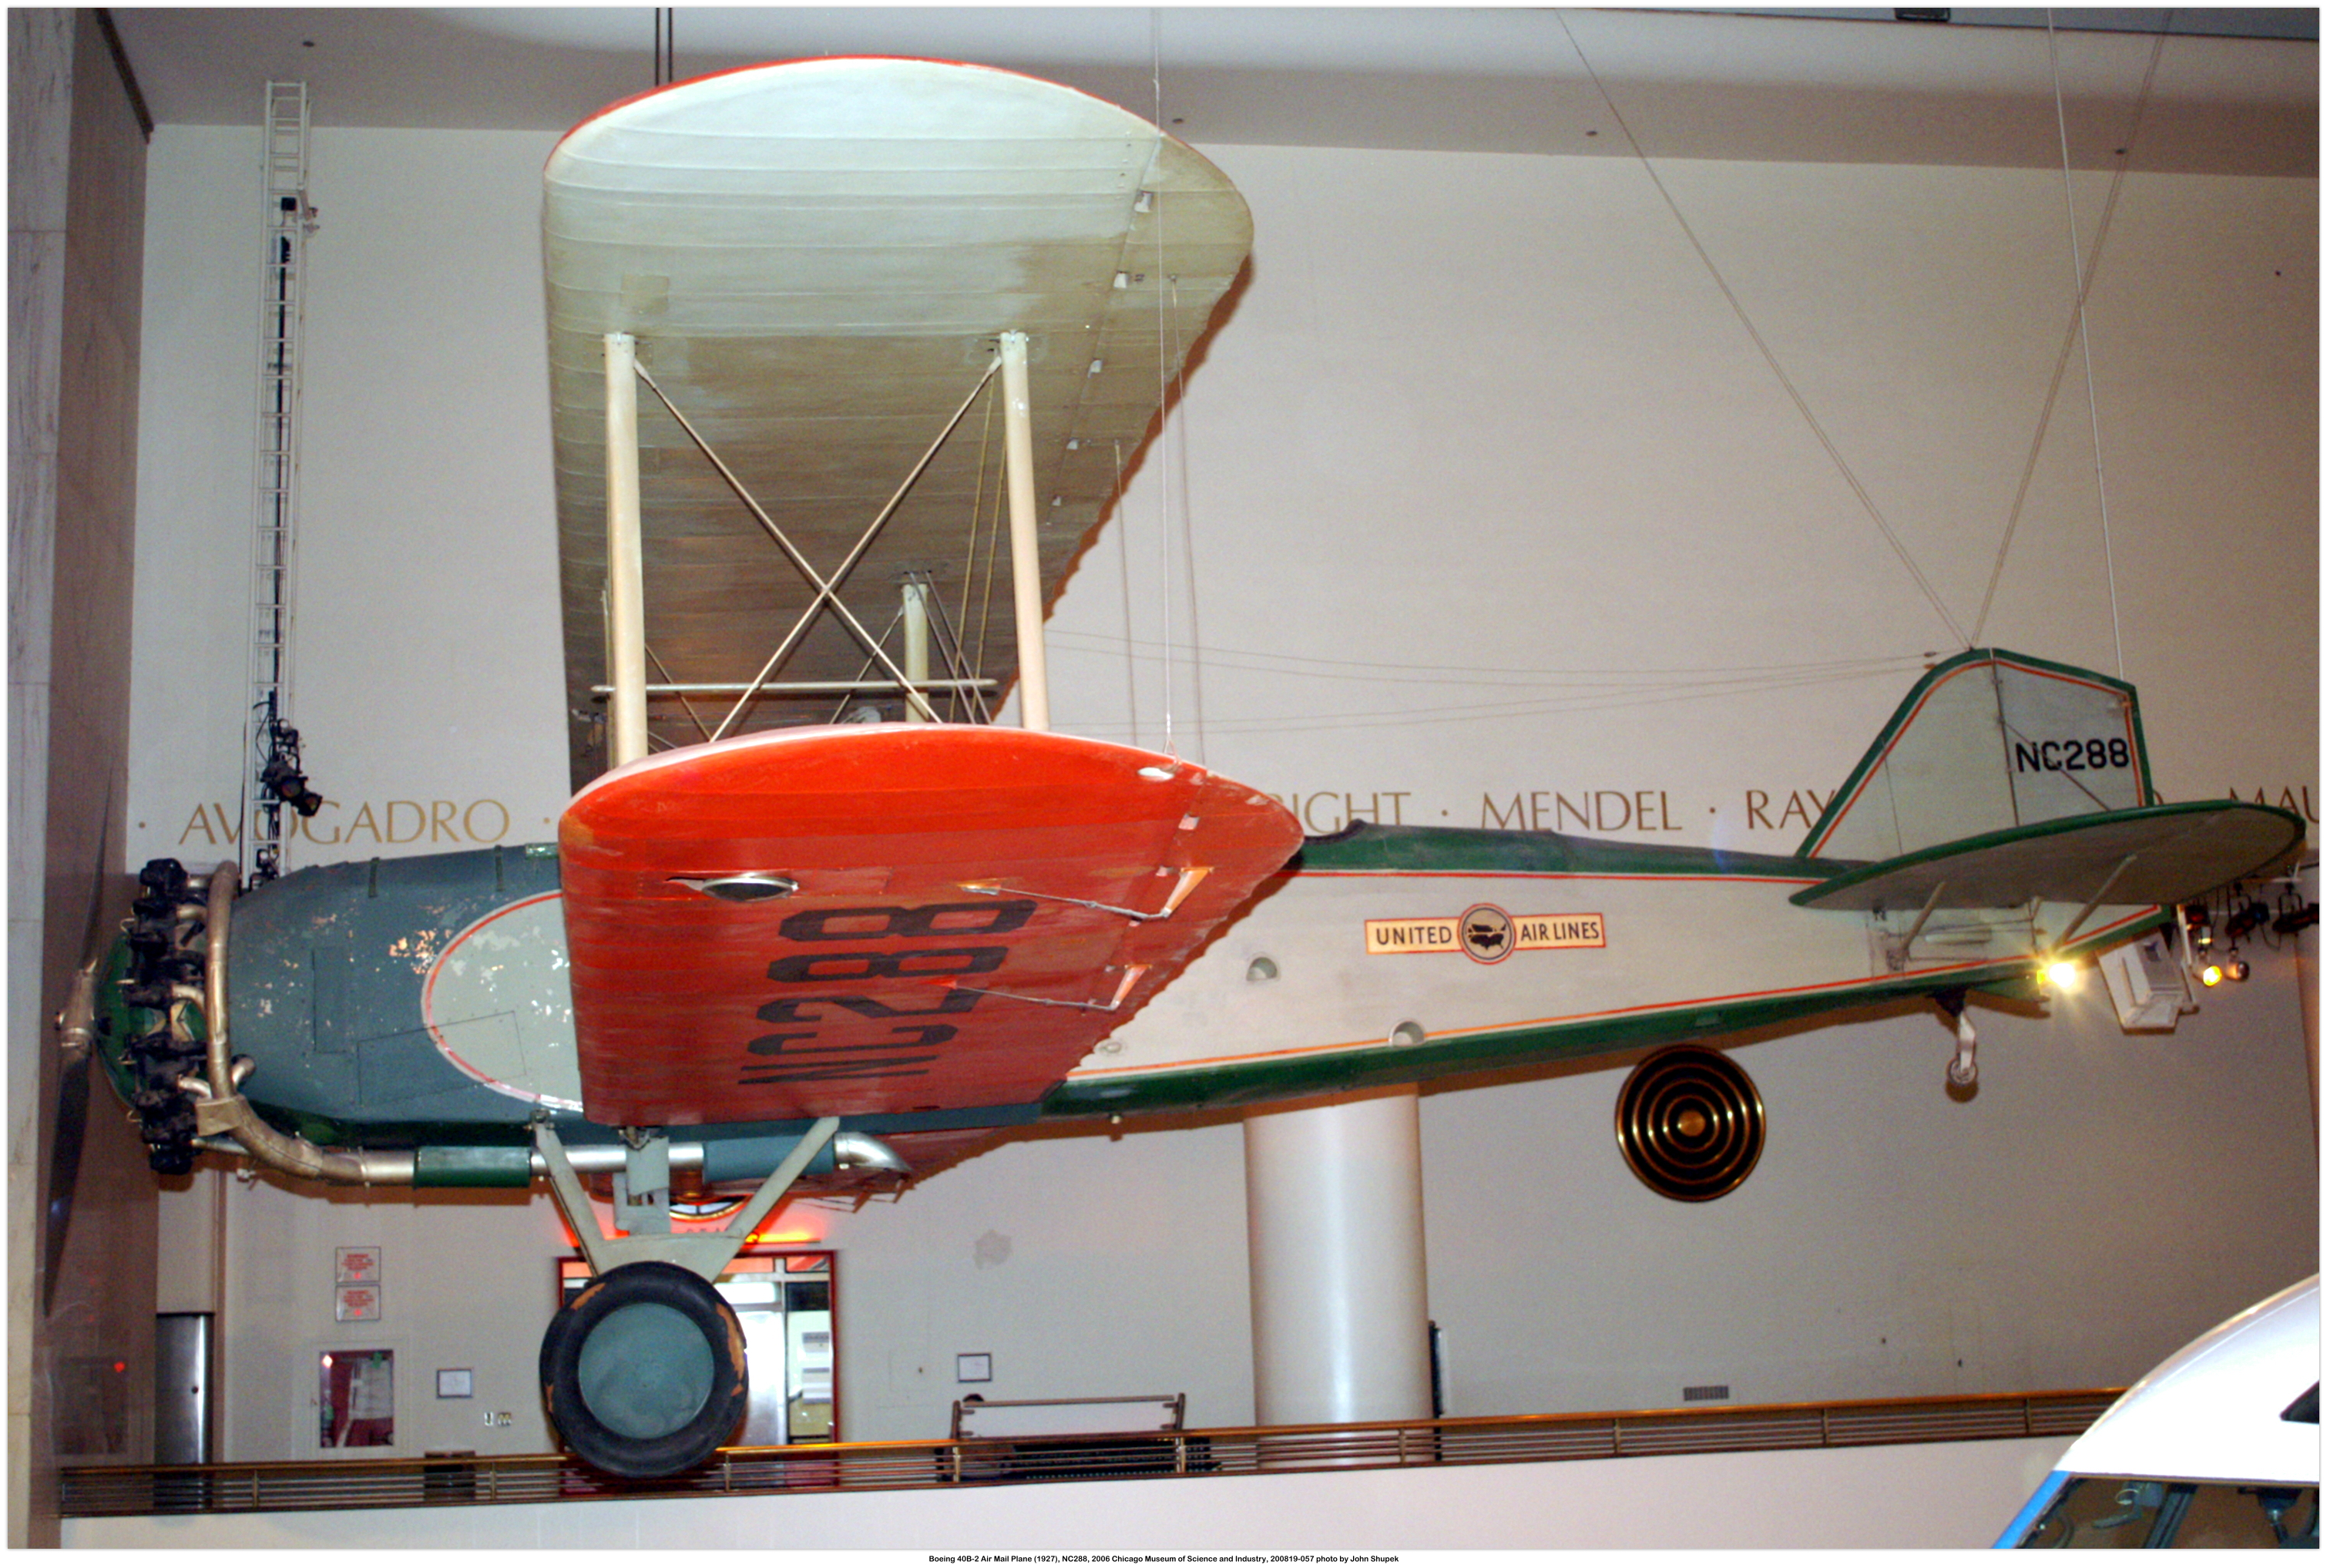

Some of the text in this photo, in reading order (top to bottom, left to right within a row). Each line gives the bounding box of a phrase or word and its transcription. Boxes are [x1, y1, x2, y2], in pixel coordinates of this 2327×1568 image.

[2015, 737, 2130, 773] NC288
[178, 798, 510, 844] AVOGADRO
[1268, 791, 1412, 834] IGHT
[1481, 790, 1683, 831] MENDEL
[1376, 922, 1600, 945] UNITED AIR LINES
[737, 899, 1038, 1085] NC288
